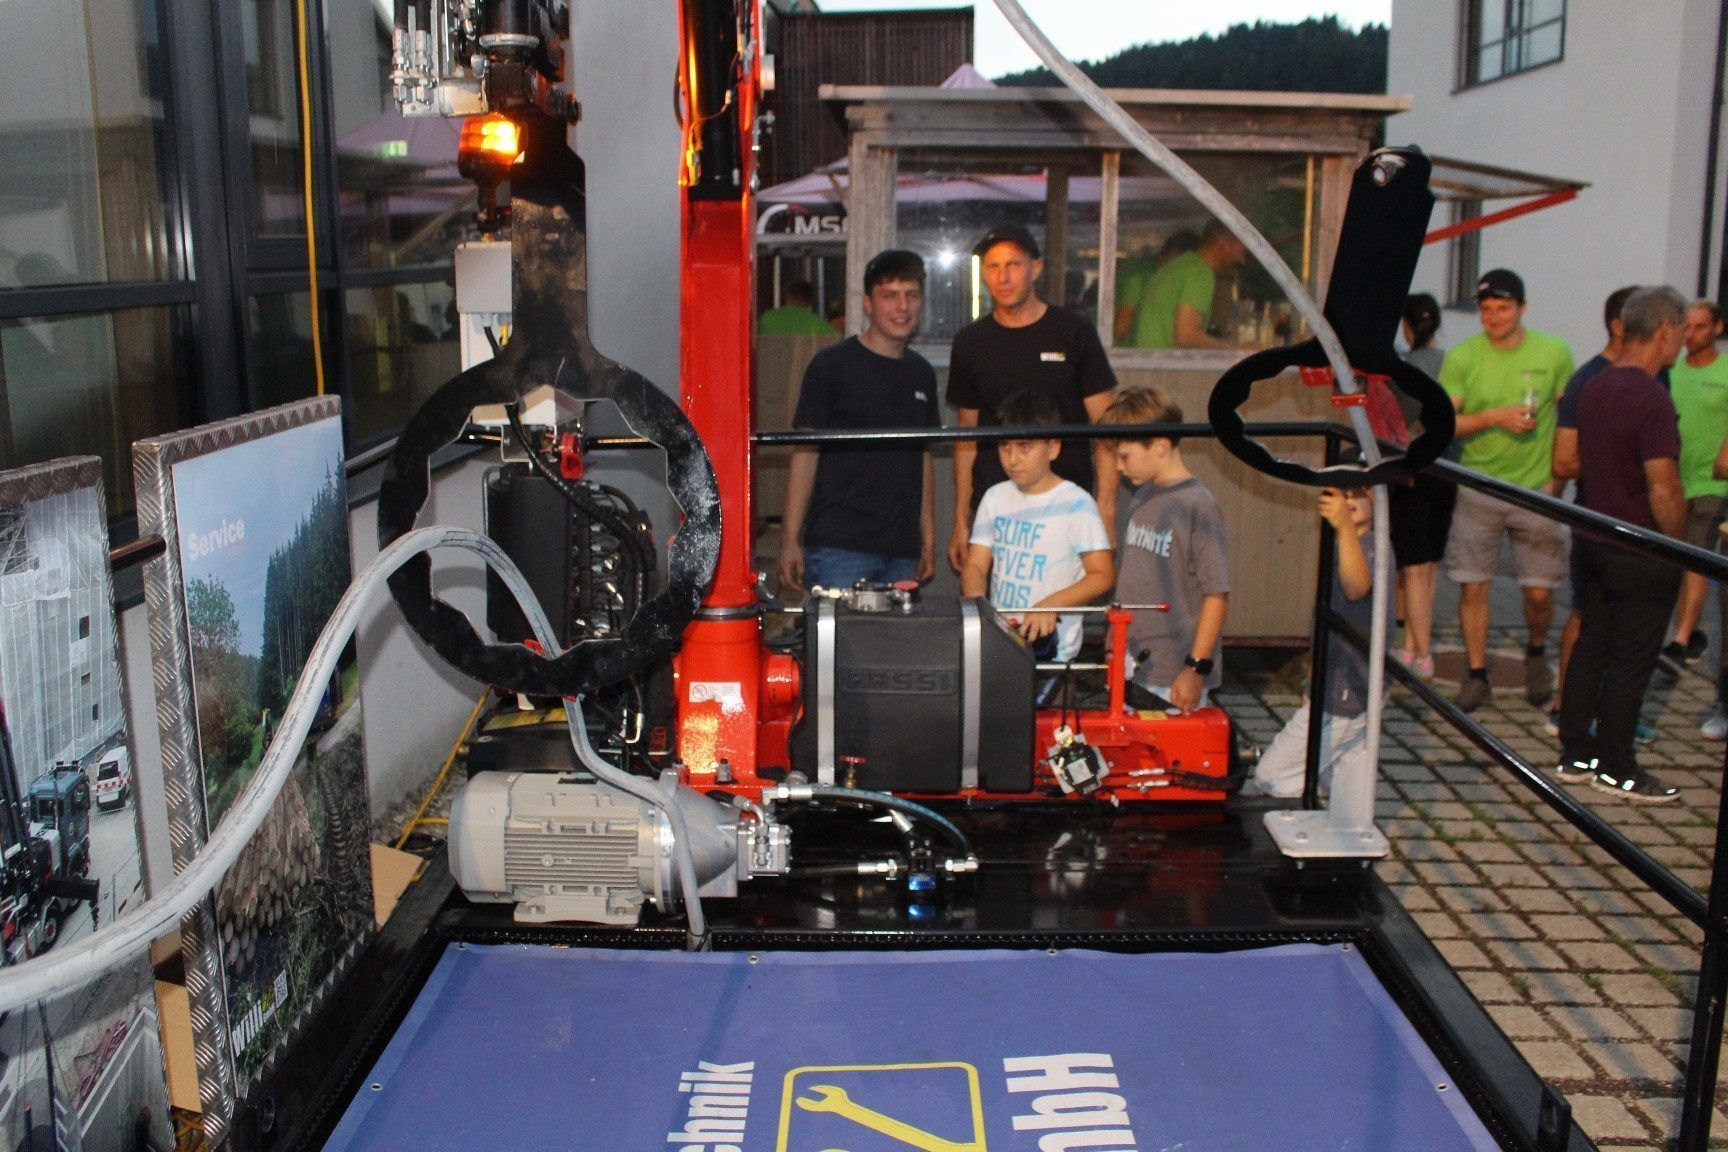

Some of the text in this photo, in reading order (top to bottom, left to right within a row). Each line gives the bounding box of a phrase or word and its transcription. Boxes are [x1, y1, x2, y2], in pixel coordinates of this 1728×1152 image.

[188, 518, 245, 561] Service
[994, 516, 1046, 550] SURF
[991, 544, 1048, 582] EVER
